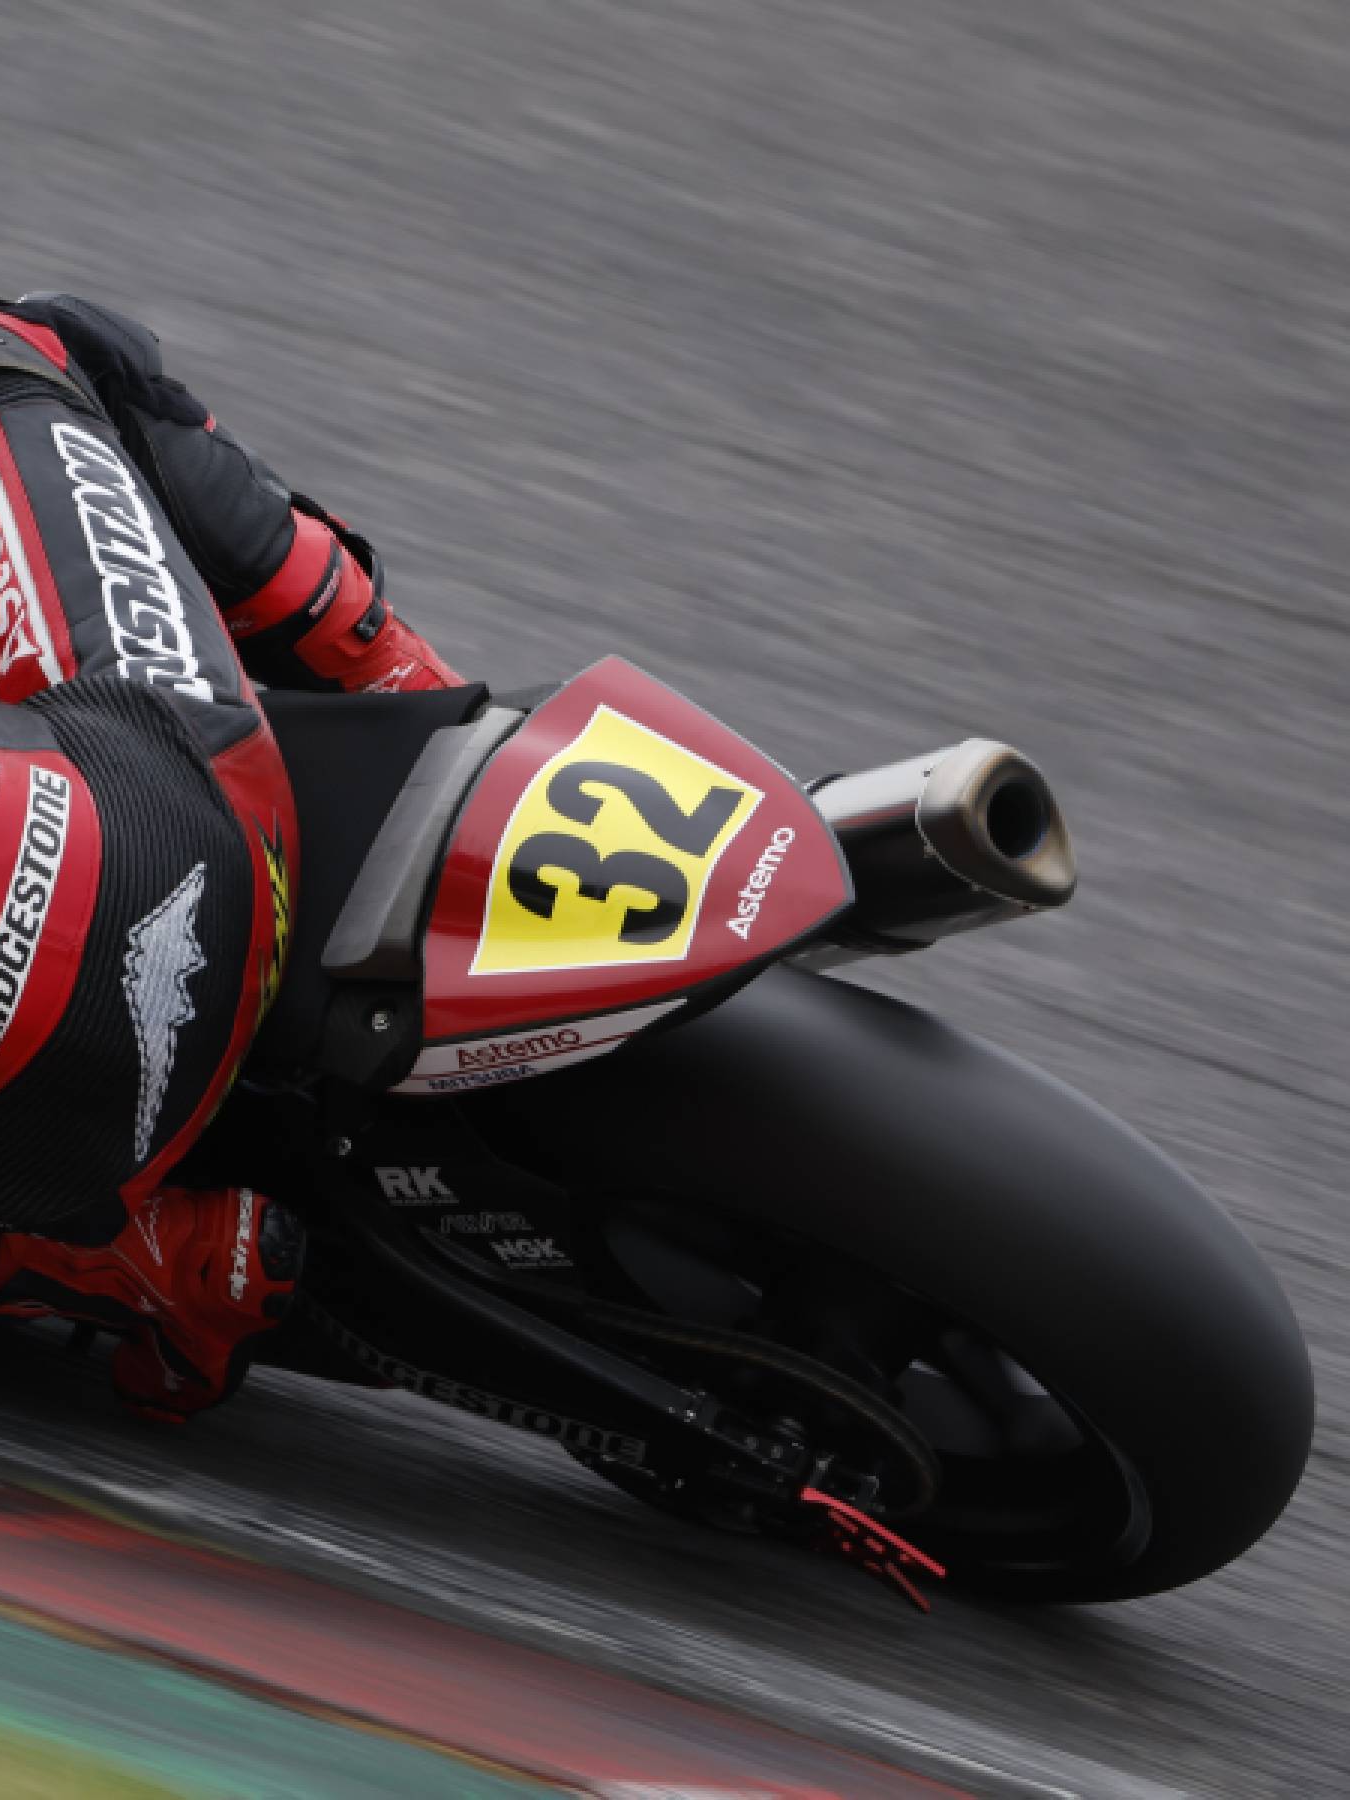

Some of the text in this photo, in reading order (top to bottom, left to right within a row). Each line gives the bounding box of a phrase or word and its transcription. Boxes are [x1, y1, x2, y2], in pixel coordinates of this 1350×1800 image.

[508, 760, 744, 945] 32
[726, 827, 795, 940] Astemo
[456, 1028, 583, 1070] Astemo
[373, 1166, 454, 1198] RK
